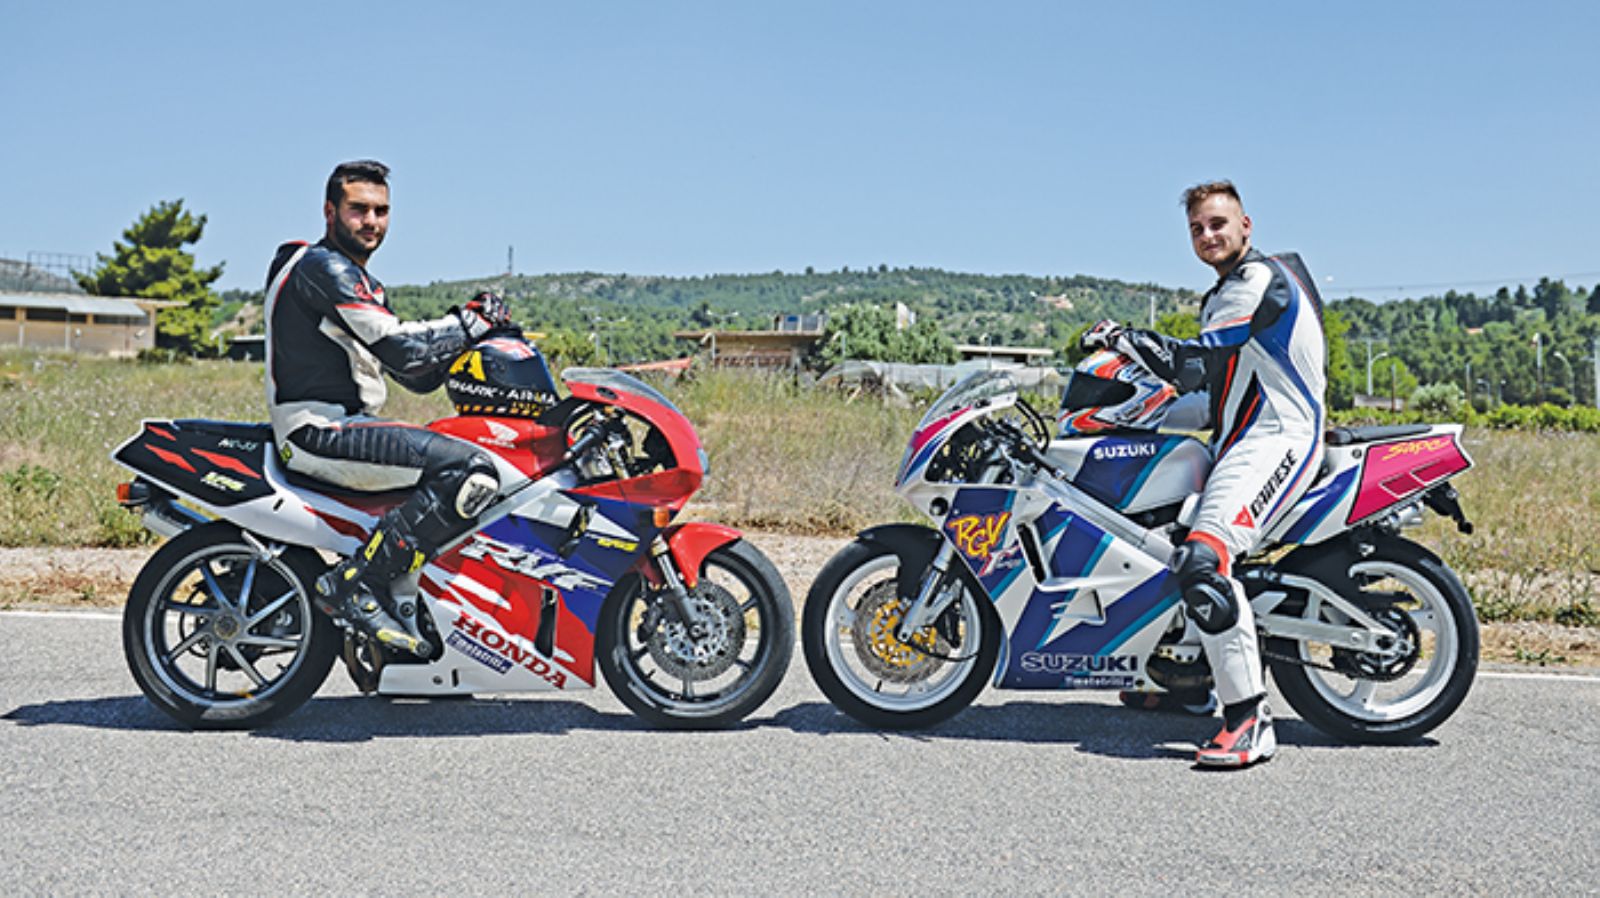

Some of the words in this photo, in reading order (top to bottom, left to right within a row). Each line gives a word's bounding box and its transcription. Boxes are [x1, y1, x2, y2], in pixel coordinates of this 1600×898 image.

[1093, 443, 1157, 460] SUZUKI
[946, 511, 1013, 560] RGV
[452, 611, 570, 690] HONDA
[1020, 652, 1139, 673] SUZUKI
